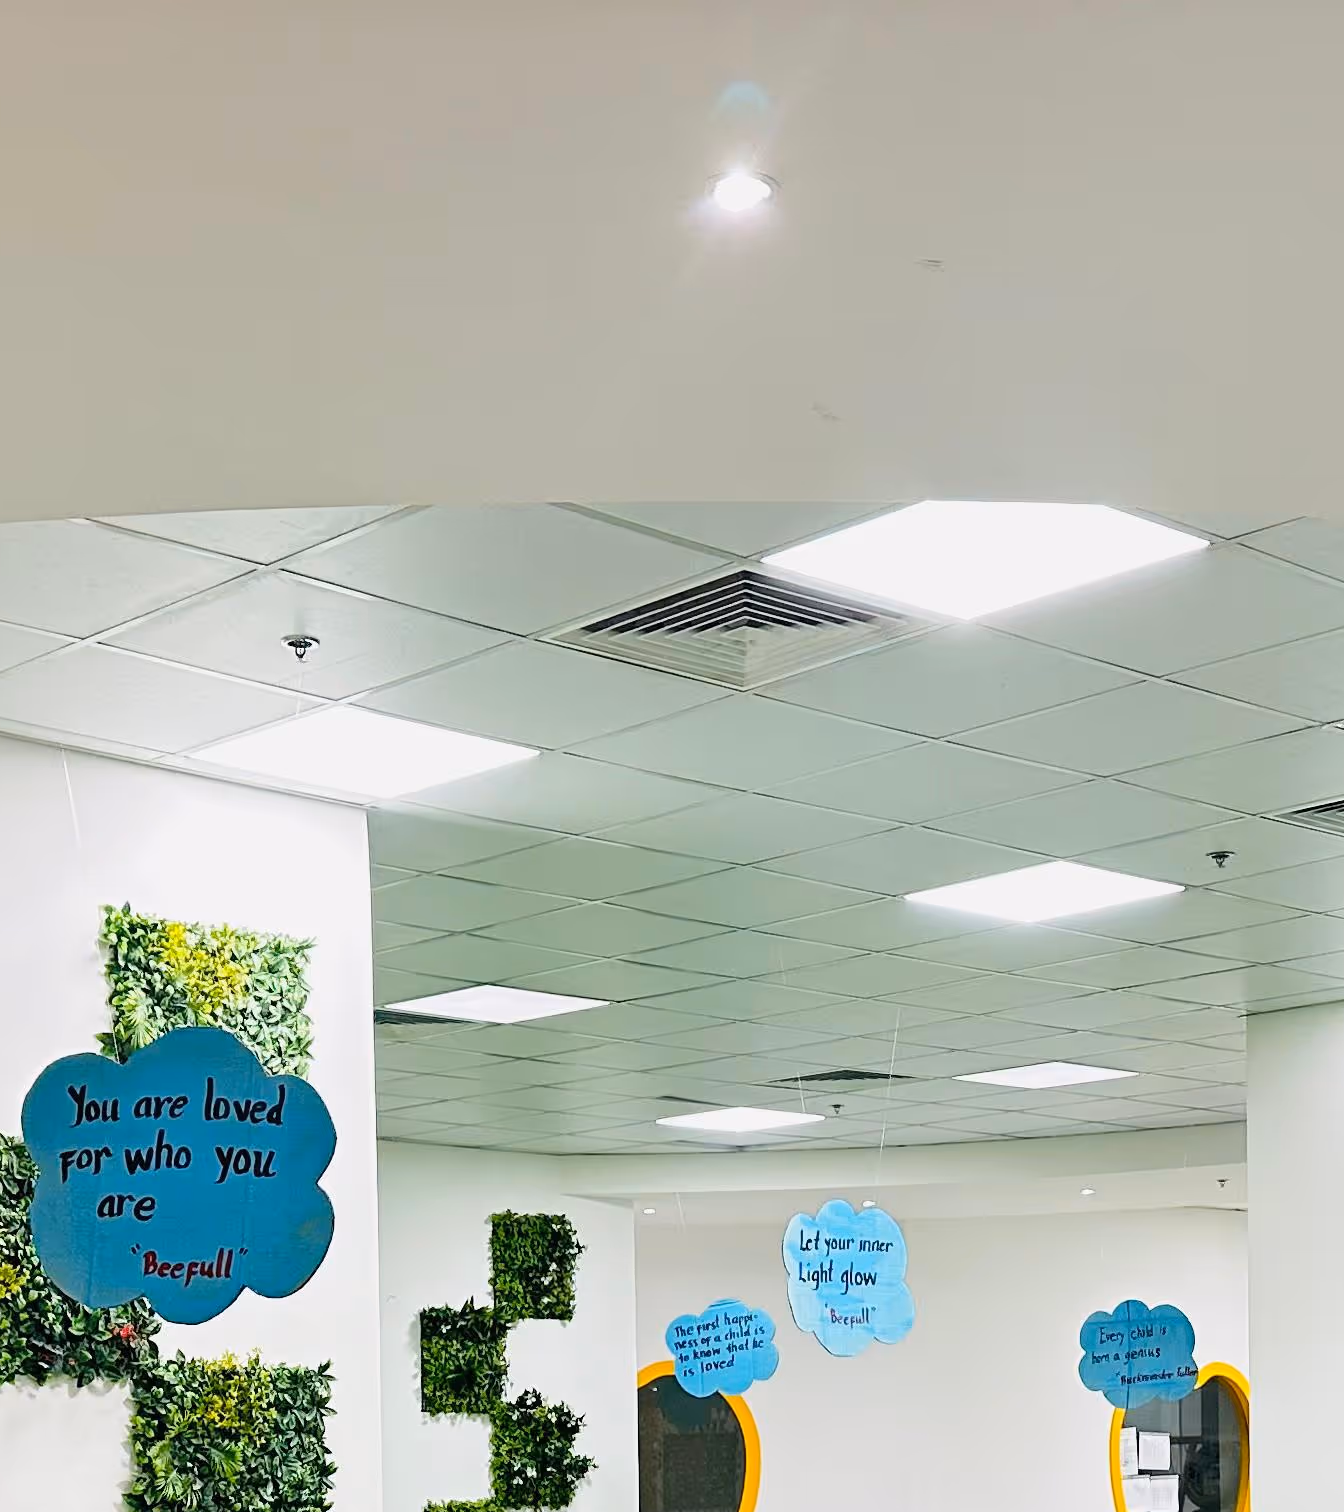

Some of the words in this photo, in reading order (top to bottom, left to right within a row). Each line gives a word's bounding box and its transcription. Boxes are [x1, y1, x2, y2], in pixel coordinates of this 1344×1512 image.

[67, 1083, 120, 1128] You
[133, 1095, 188, 1120] are
[203, 1076, 285, 1126] loved
[124, 1129, 192, 1176] who
[214, 1145, 277, 1184] you
[96, 1192, 156, 1221] are
[799, 1229, 820, 1251] Let
[824, 1237, 854, 1257] your
[858, 1234, 894, 1252] inner
[798, 1259, 833, 1290] Light
[840, 1261, 877, 1295] glow
[674, 1325, 694, 1337] The
[696, 1314, 719, 1335] first
[674, 1338, 698, 1351] ness
[700, 1336, 712, 1347] of
[724, 1325, 751, 1341] child
[754, 1326, 765, 1336] is
[1099, 1326, 1124, 1346] Every
[1130, 1324, 1153, 1340] child
[1159, 1324, 1167, 1335] is
[678, 1353, 689, 1363] to
[692, 1347, 721, 1360] know
[726, 1338, 749, 1353] that
[752, 1337, 764, 1349] he
[1113, 1353, 1120, 1361] a
[1123, 1348, 1161, 1365] genius
[683, 1366, 695, 1377] is
[701, 1354, 735, 1373] loved
